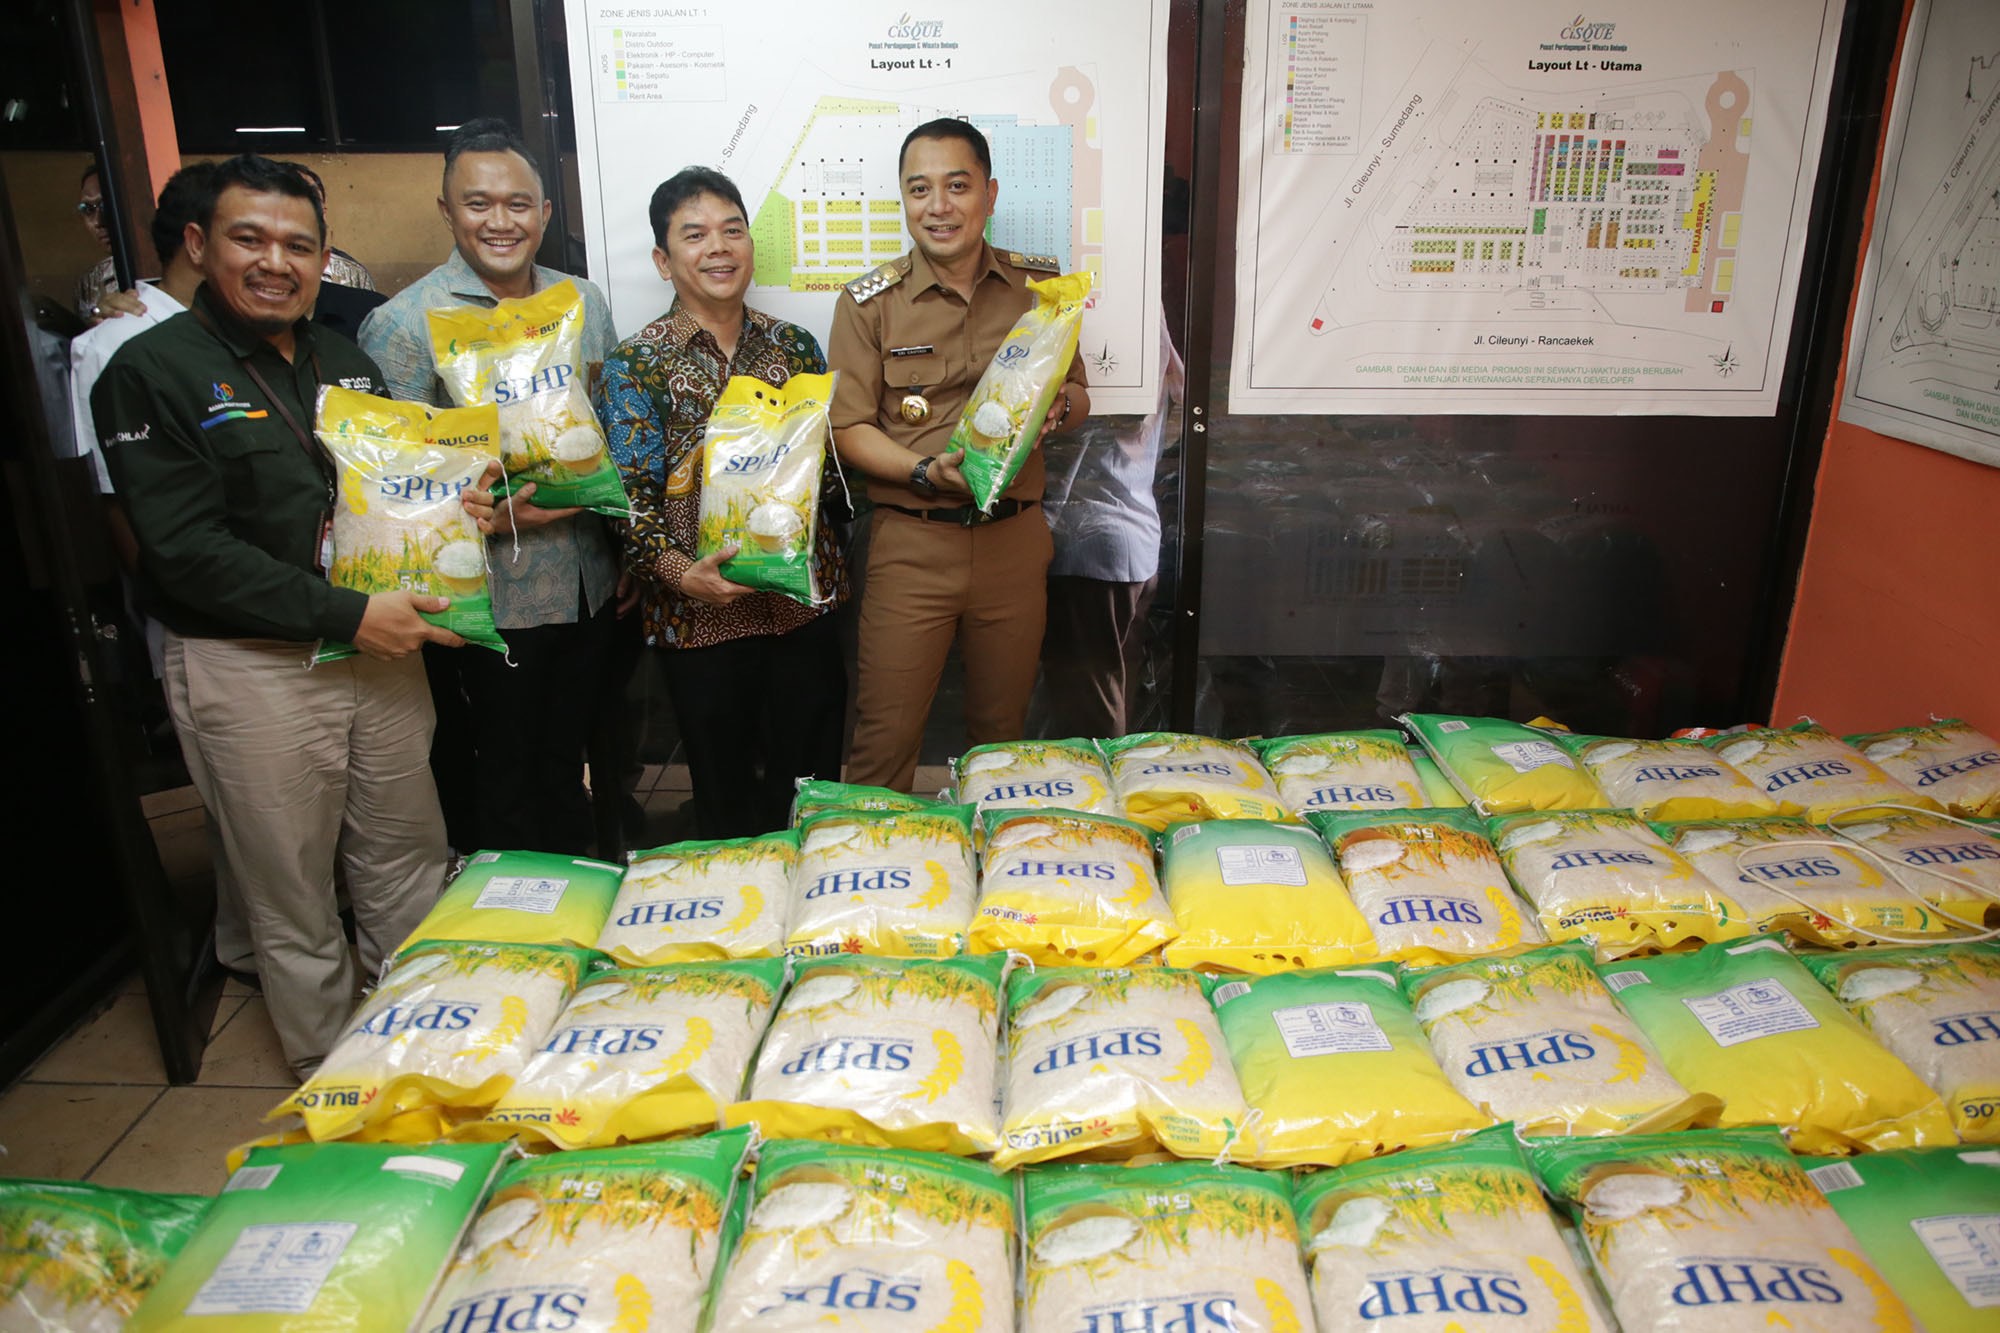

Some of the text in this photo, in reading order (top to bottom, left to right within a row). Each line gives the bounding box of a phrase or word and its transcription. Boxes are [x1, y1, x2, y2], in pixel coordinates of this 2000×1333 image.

[600, 9, 624, 18] ZONE
[626, 9, 651, 18] JENIS
[653, 8, 687, 18] JUALAN
[871, 59, 915, 71] Layout
[919, 59, 932, 69] Lt
[945, 59, 951, 69] 1
[1528, 60, 1572, 72] Layout
[1576, 60, 1589, 70] Lt
[1601, 61, 1642, 71] Utama
[722, 103, 758, 158] Sumedang
[1351, 155, 1381, 195] Cileunyi
[1382, 94, 1423, 148] Sumedang
[1692, 202, 1706, 254] PUJASERA
[805, 283, 831, 291] FOOD
[1488, 335, 1528, 348] Cileunyi
[1538, 335, 1594, 346] Rancaekek
[1397, 366, 1426, 374] DENAH
[1429, 366, 1446, 374] DAN
[1461, 366, 1488, 374] MEDIA
[1492, 366, 1531, 374] PROMOSI
[1622, 367, 1641, 375] BISA
[1642, 367, 1684, 375] BERUBAH
[1404, 375, 1634, 385] DAN MENJADI KEWENANGAN SEPENUHNYA DEVELOPER
[495, 364, 573, 404] SPHP
[438, 433, 489, 447] BULOG
[400, 575, 429, 592] 5 kg
[1142, 764, 1231, 778] SPHP
[1635, 766, 1721, 783] SPHP
[1766, 762, 1852, 792] SPHP
[1918, 752, 2000, 787] SPHP
[983, 782, 1075, 802] SPHP
[1306, 787, 1395, 806] SPHP
[1422, 828, 1434, 839] 5
[1551, 850, 1654, 870] SPHP
[1904, 844, 2000, 866] SPHP
[1007, 861, 1116, 881] SPHP
[1738, 859, 1841, 883] SPHP
[805, 869, 912, 900] SPHP
[616, 899, 724, 928] SPHP
[982, 906, 1023, 921] BULOG
[1378, 899, 1483, 926] SPHP
[1560, 911, 1615, 929] BULOG
[781, 1043, 913, 1075] SPHP
[1033, 1031, 1162, 1075] SPHP
[1465, 1033, 1596, 1078] SPHP
[1700, 1158, 1722, 1175] 5
[560, 1178, 604, 1198] 5 kg
[889, 1175, 907, 1192] 5
[1415, 1177, 1436, 1193] 5
[1171, 1193, 1191, 1209] 5
[1672, 1264, 1843, 1307] SPHP
[1359, 1275, 1528, 1321] SPHP
